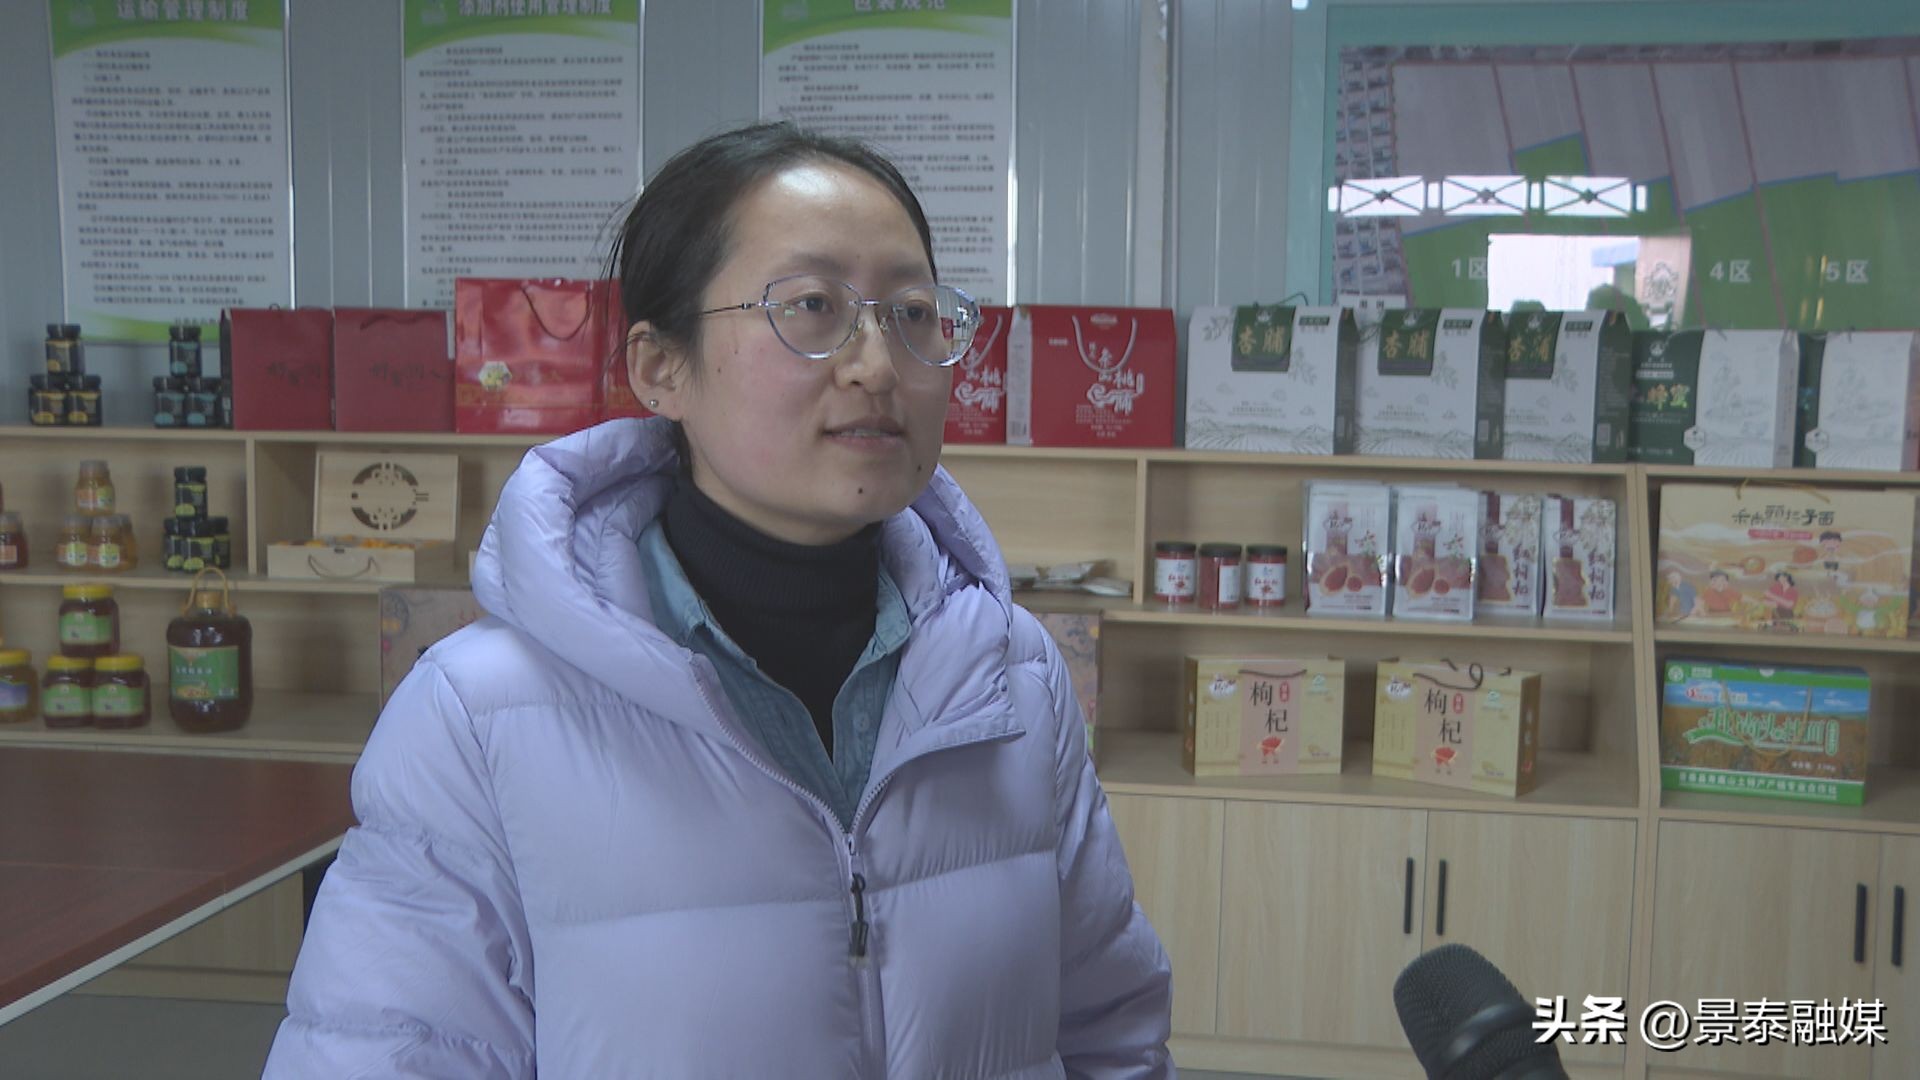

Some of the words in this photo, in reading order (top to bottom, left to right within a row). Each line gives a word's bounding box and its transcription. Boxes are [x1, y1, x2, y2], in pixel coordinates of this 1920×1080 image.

[1710, 260, 1751, 283] 4区
[1826, 260, 1869, 283] 5区
[1238, 326, 1285, 356] 杏脯
[1383, 331, 1428, 360] 杏脯
[1647, 383, 1690, 411] 蜂蜜
[1249, 681, 1288, 734] 枸杞
[1424, 687, 1464, 743] 枸杞
